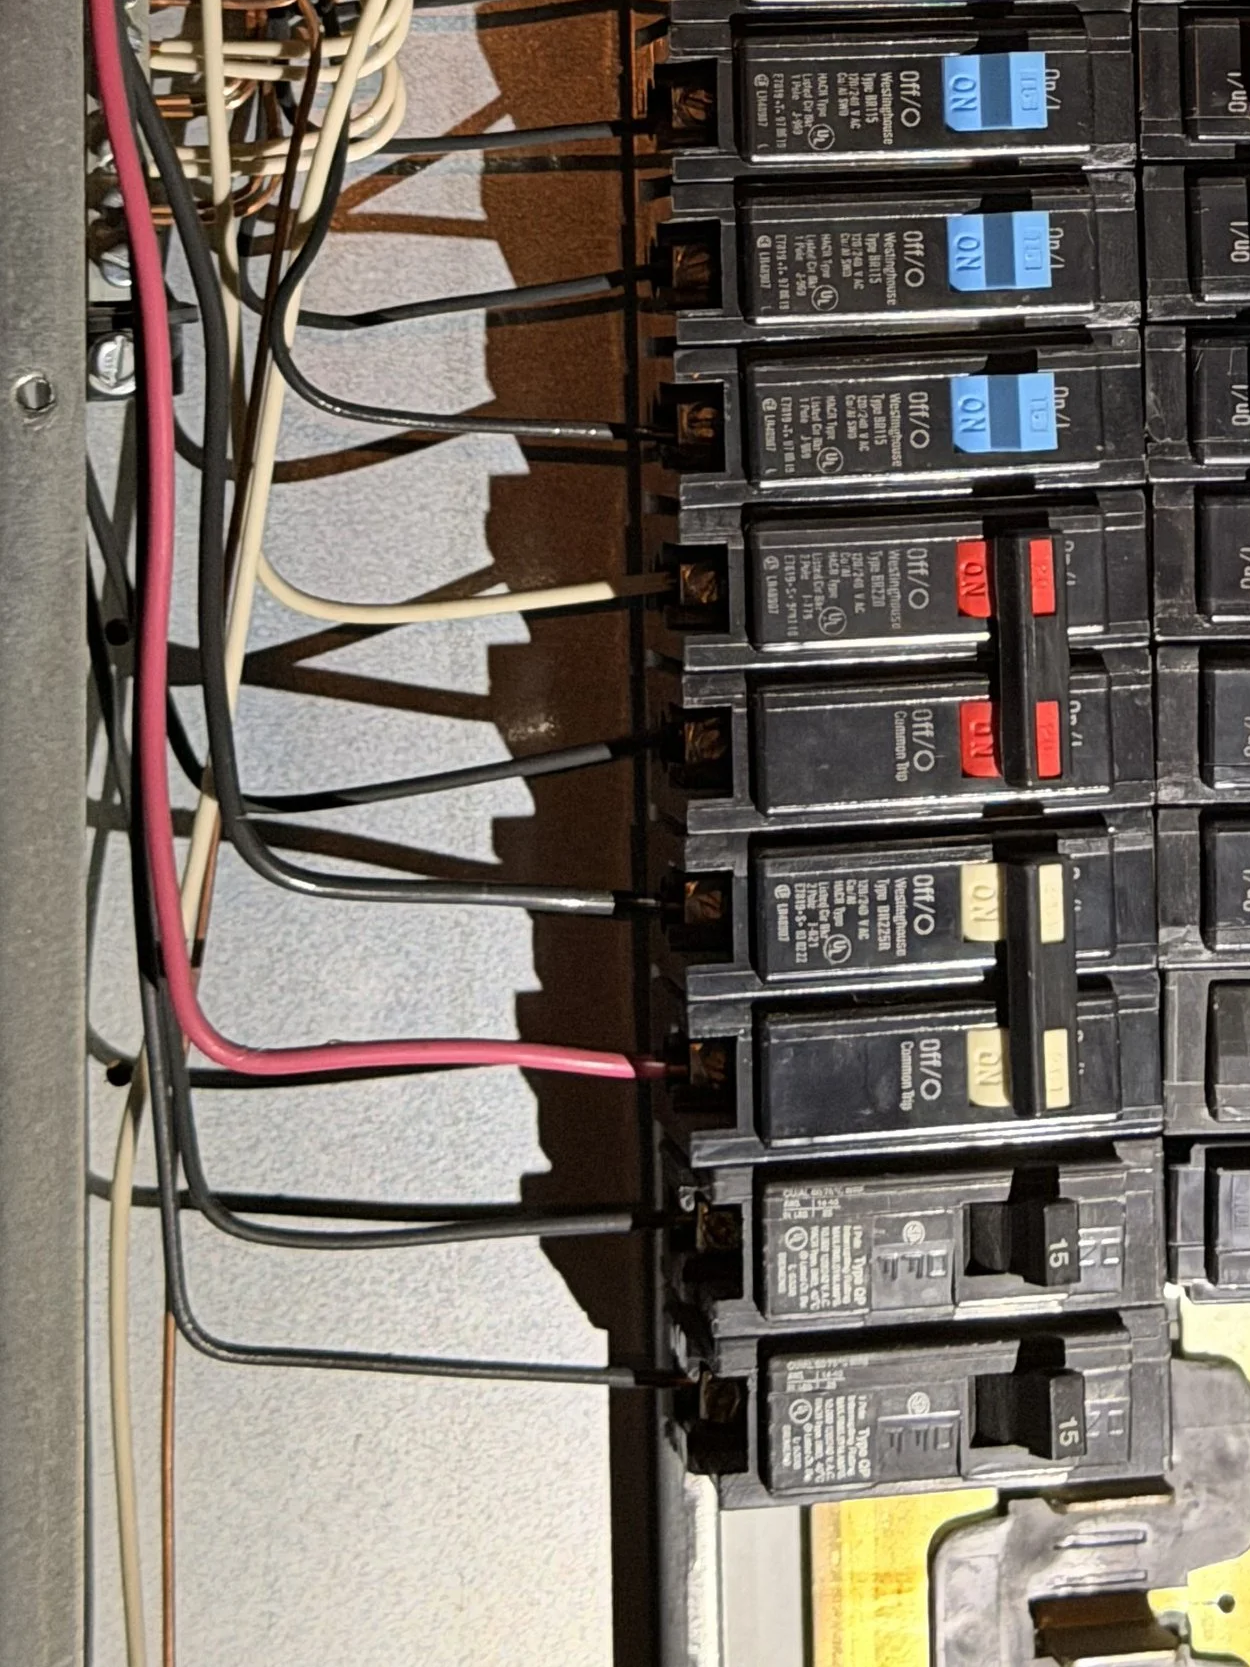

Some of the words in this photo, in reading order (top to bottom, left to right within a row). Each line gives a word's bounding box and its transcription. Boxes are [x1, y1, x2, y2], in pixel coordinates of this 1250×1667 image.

[881, 72, 894, 145] Westinghouse
[949, 76, 976, 113] ON
[884, 232, 898, 305] Westinghouse
[955, 236, 981, 272] ON
[890, 392, 902, 467] Westinghouse
[958, 397, 986, 434] ON
[887, 549, 902, 629] Westinghouse
[960, 562, 986, 597] ON
[894, 711, 909, 754] Common
[969, 721, 993, 759] ON
[893, 756, 909, 783] Trip
[894, 877, 908, 957] Westinghouse
[978, 884, 997, 925] ON
[900, 1040, 915, 1082] Common
[981, 1051, 1001, 1087] ON
[899, 1086, 914, 1111] Trip
[854, 1257, 870, 1284] Type
[1047, 1237, 1070, 1268] 15
[857, 1426, 872, 1454] Type
[1057, 1416, 1080, 1447] 15
